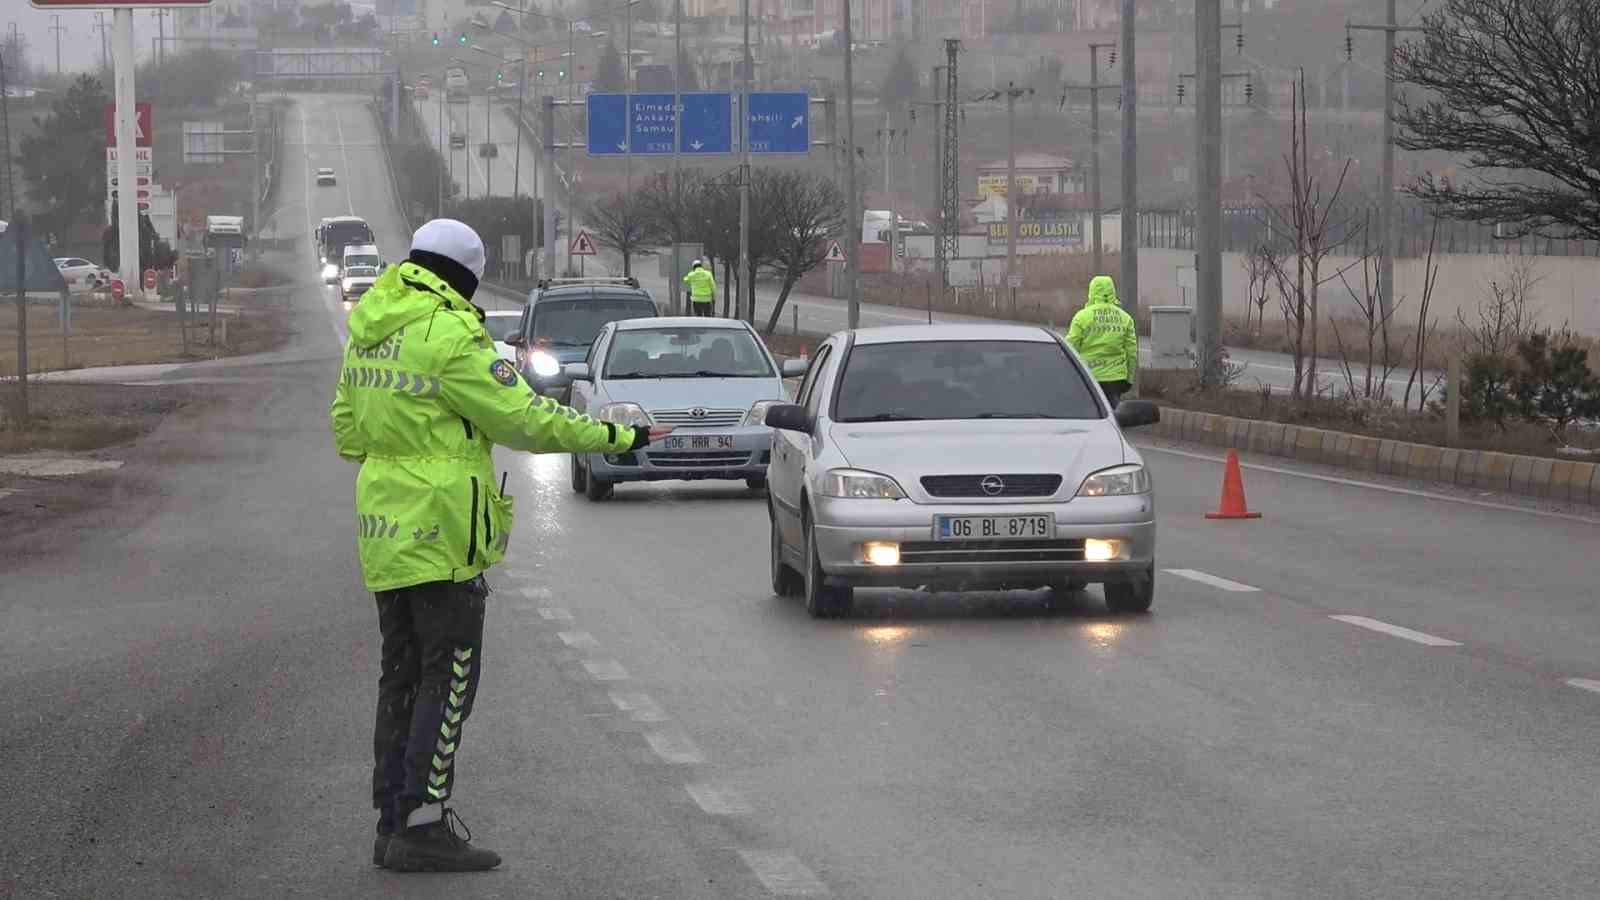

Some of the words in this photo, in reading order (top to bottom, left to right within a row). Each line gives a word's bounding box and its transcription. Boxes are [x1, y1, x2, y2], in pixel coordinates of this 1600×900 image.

[635, 124, 674, 133] Samsu
[1020, 223, 1041, 237] OTO
[671, 437, 684, 449] 06
[952, 519, 972, 536] 06
[982, 519, 1001, 536] BL
[1008, 518, 1046, 536] 8719
